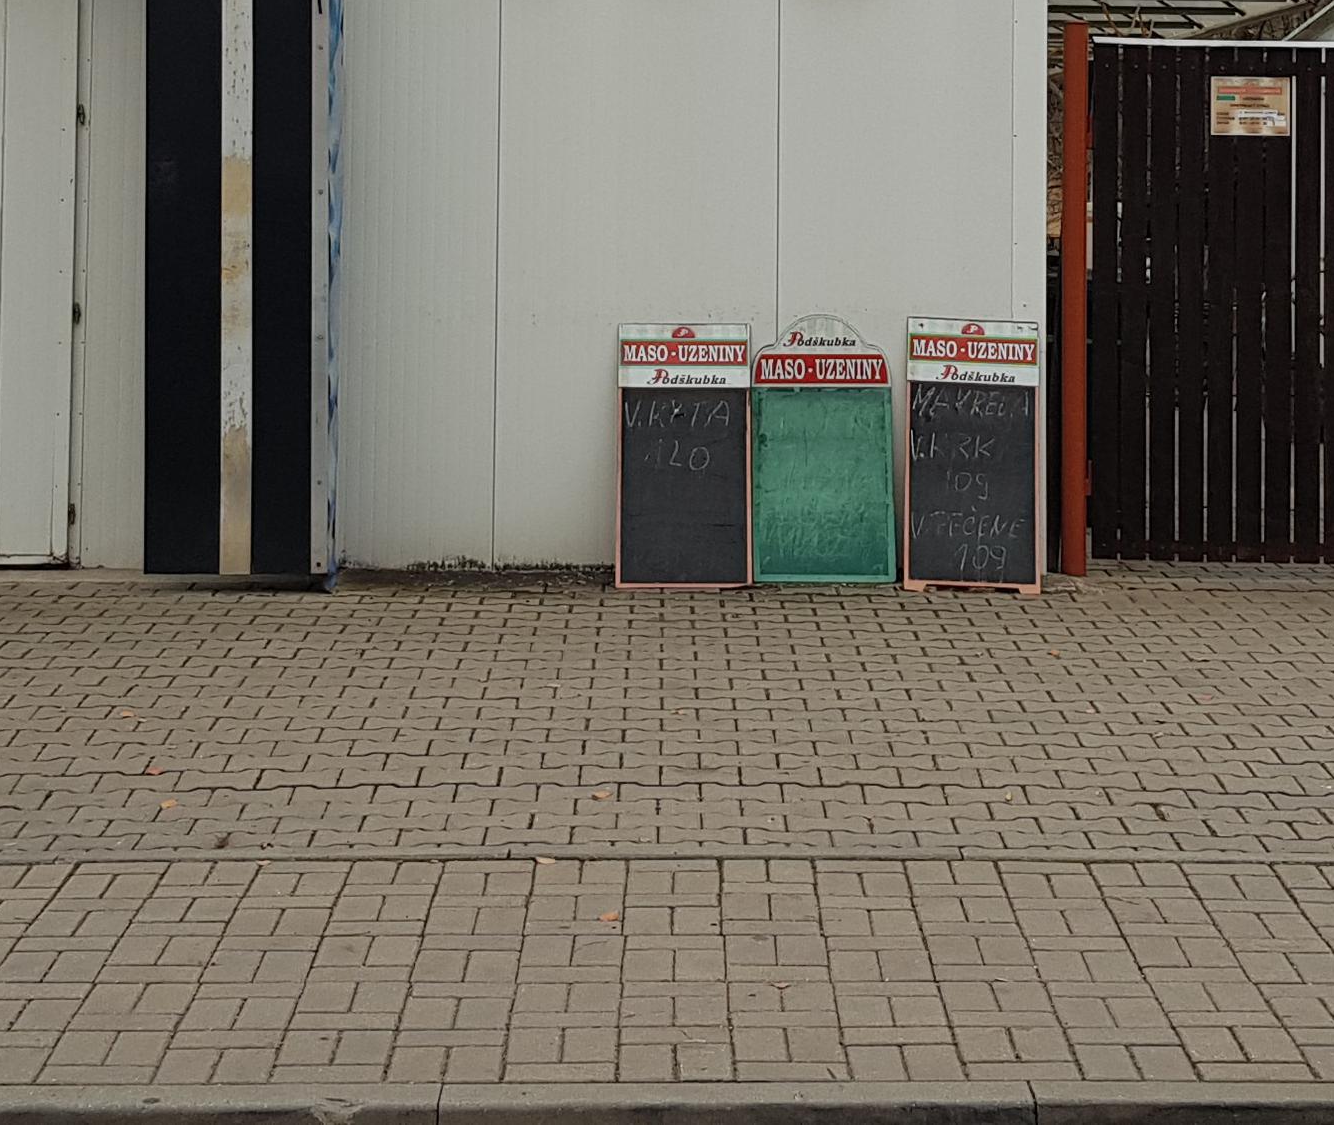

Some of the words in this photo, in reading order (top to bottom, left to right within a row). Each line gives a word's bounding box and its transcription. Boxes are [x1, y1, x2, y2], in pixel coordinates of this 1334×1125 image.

[783, 331, 856, 347] Podškubka
[623, 345, 668, 362] MASO
[678, 345, 745, 362] UZENINY
[912, 339, 957, 357] MASO
[967, 342, 1035, 361] UZENINY
[647, 368, 726, 385] Podškubka
[761, 359, 805, 380] MASO
[815, 359, 883, 380] UZENINY
[936, 365, 1015, 383] Podškubka
